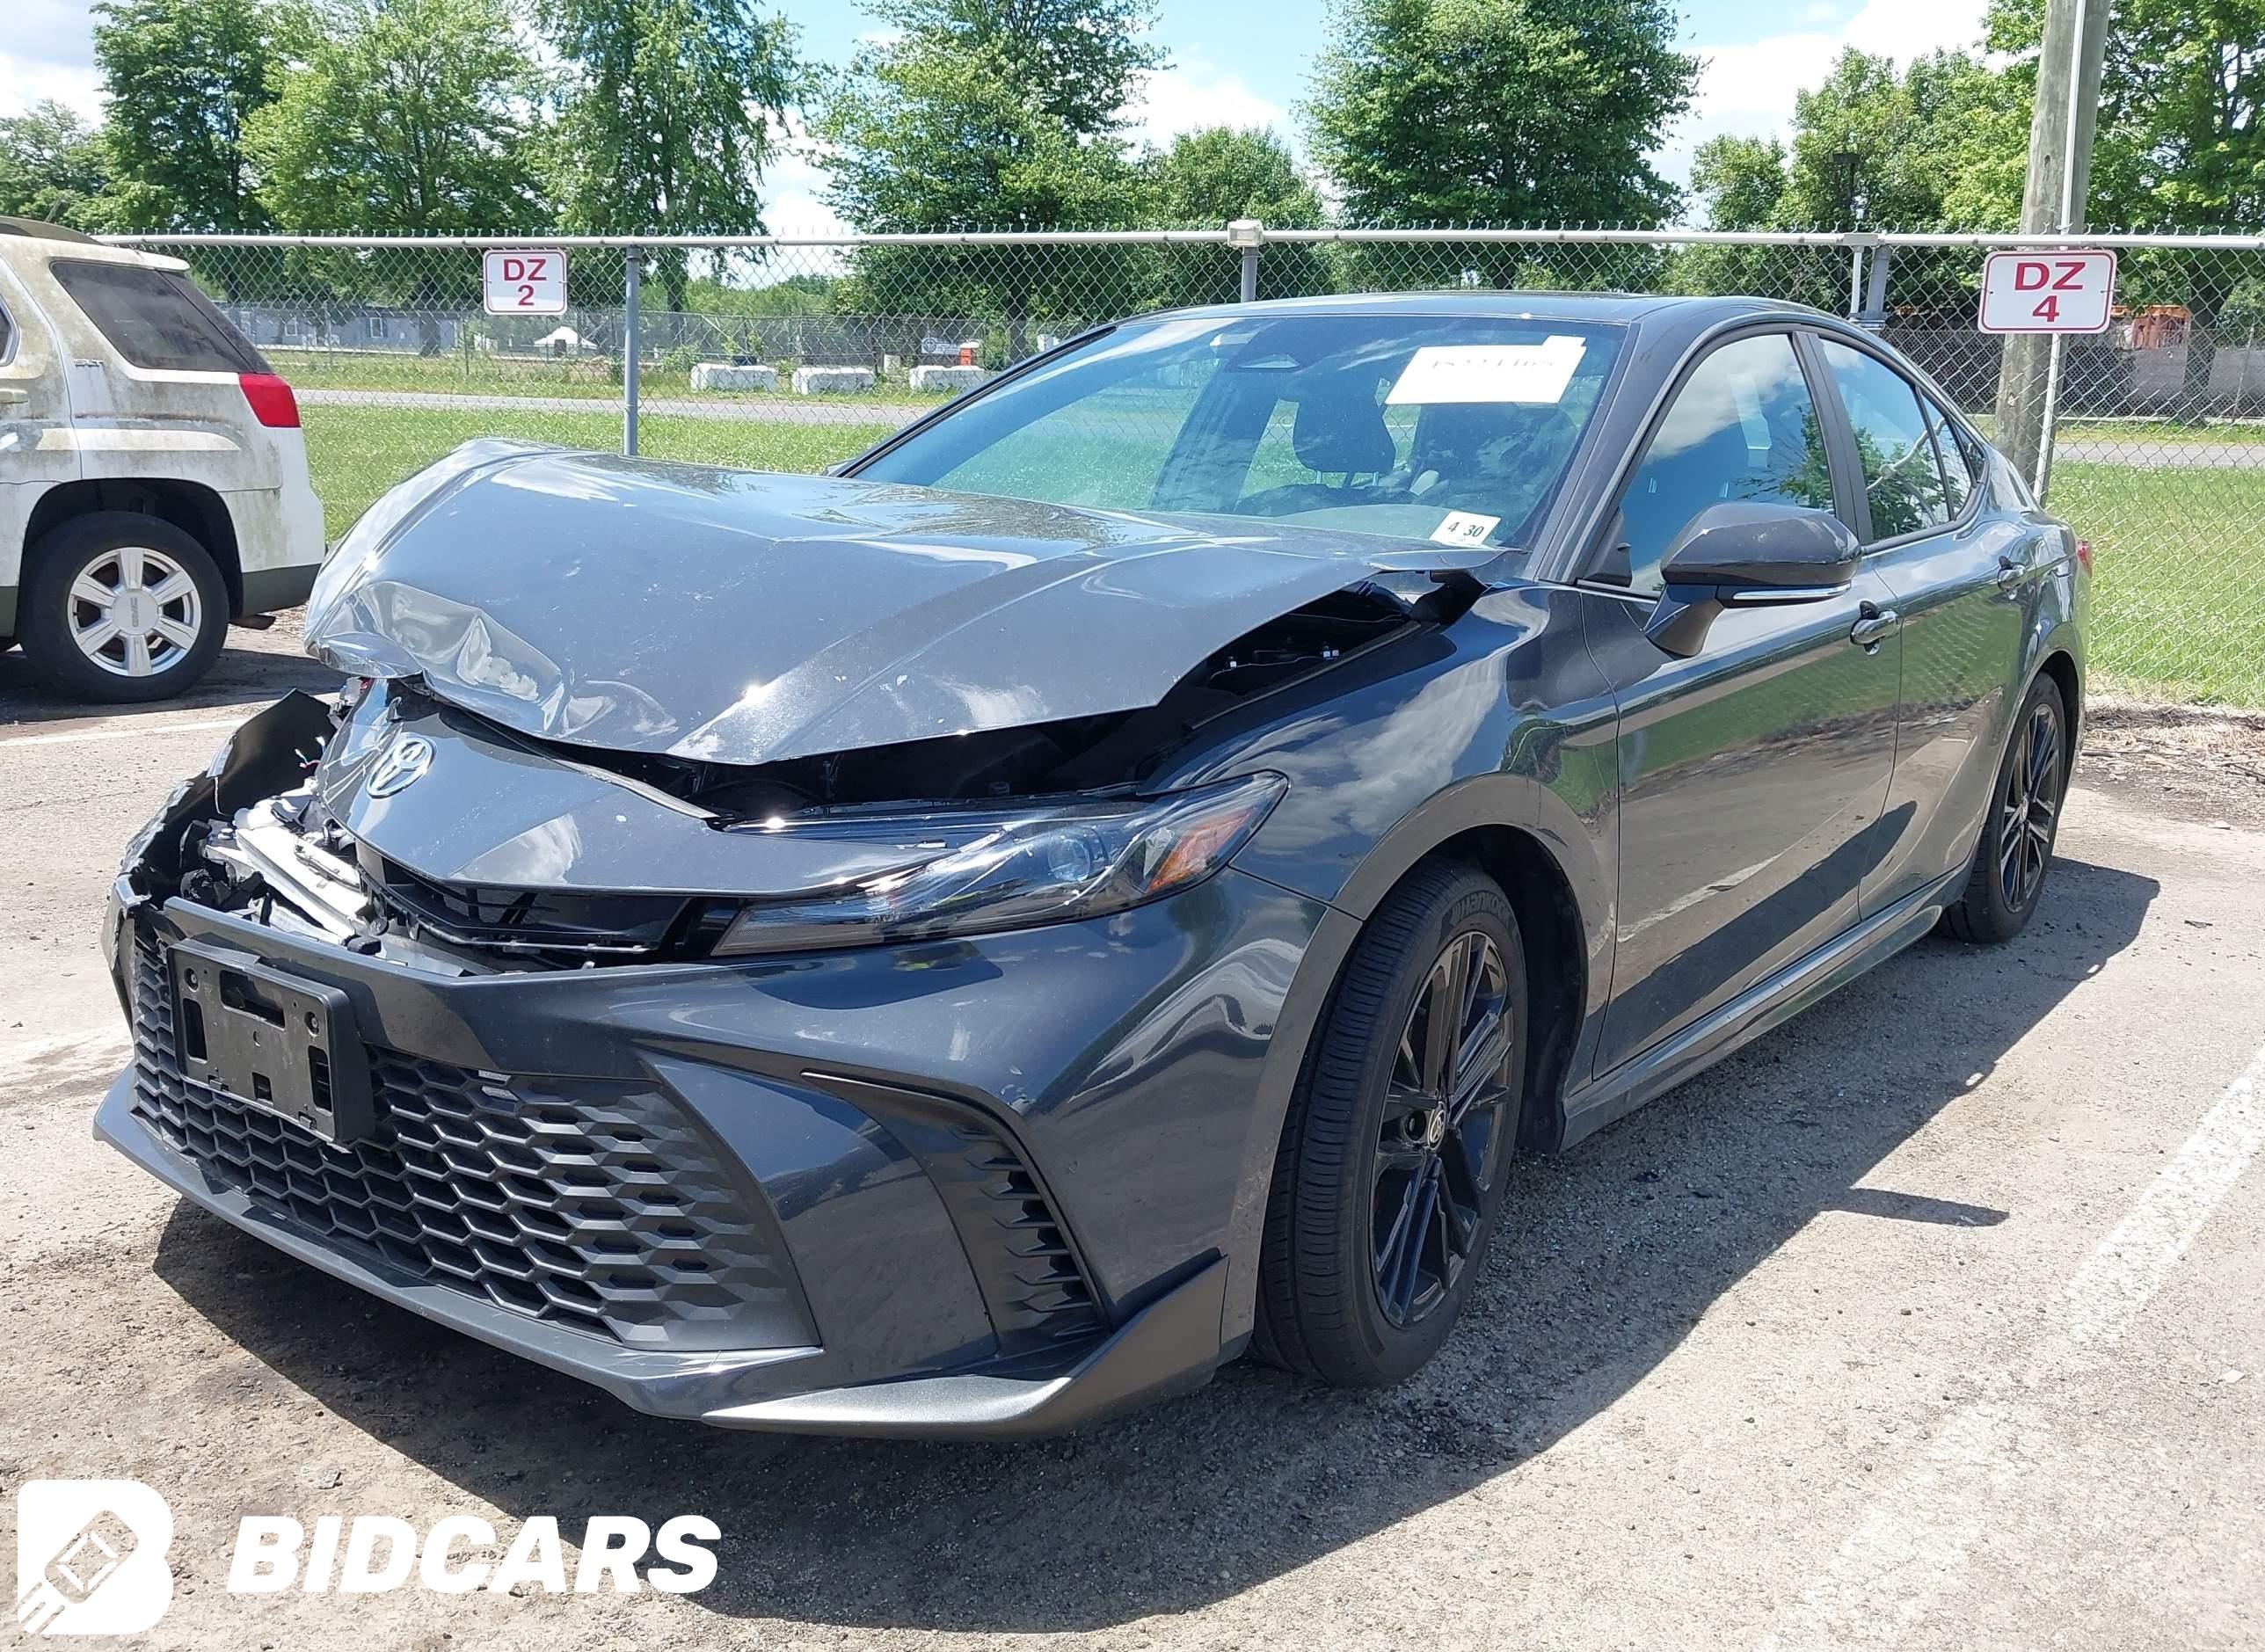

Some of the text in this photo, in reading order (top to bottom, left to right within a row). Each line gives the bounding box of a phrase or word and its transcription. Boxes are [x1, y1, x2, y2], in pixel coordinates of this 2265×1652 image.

[504, 258, 547, 280] DZ
[2014, 262, 2086, 290] DZ
[518, 285, 535, 306] 2
[2032, 295, 2060, 323] 4
[1448, 521, 1485, 537] 4 30
